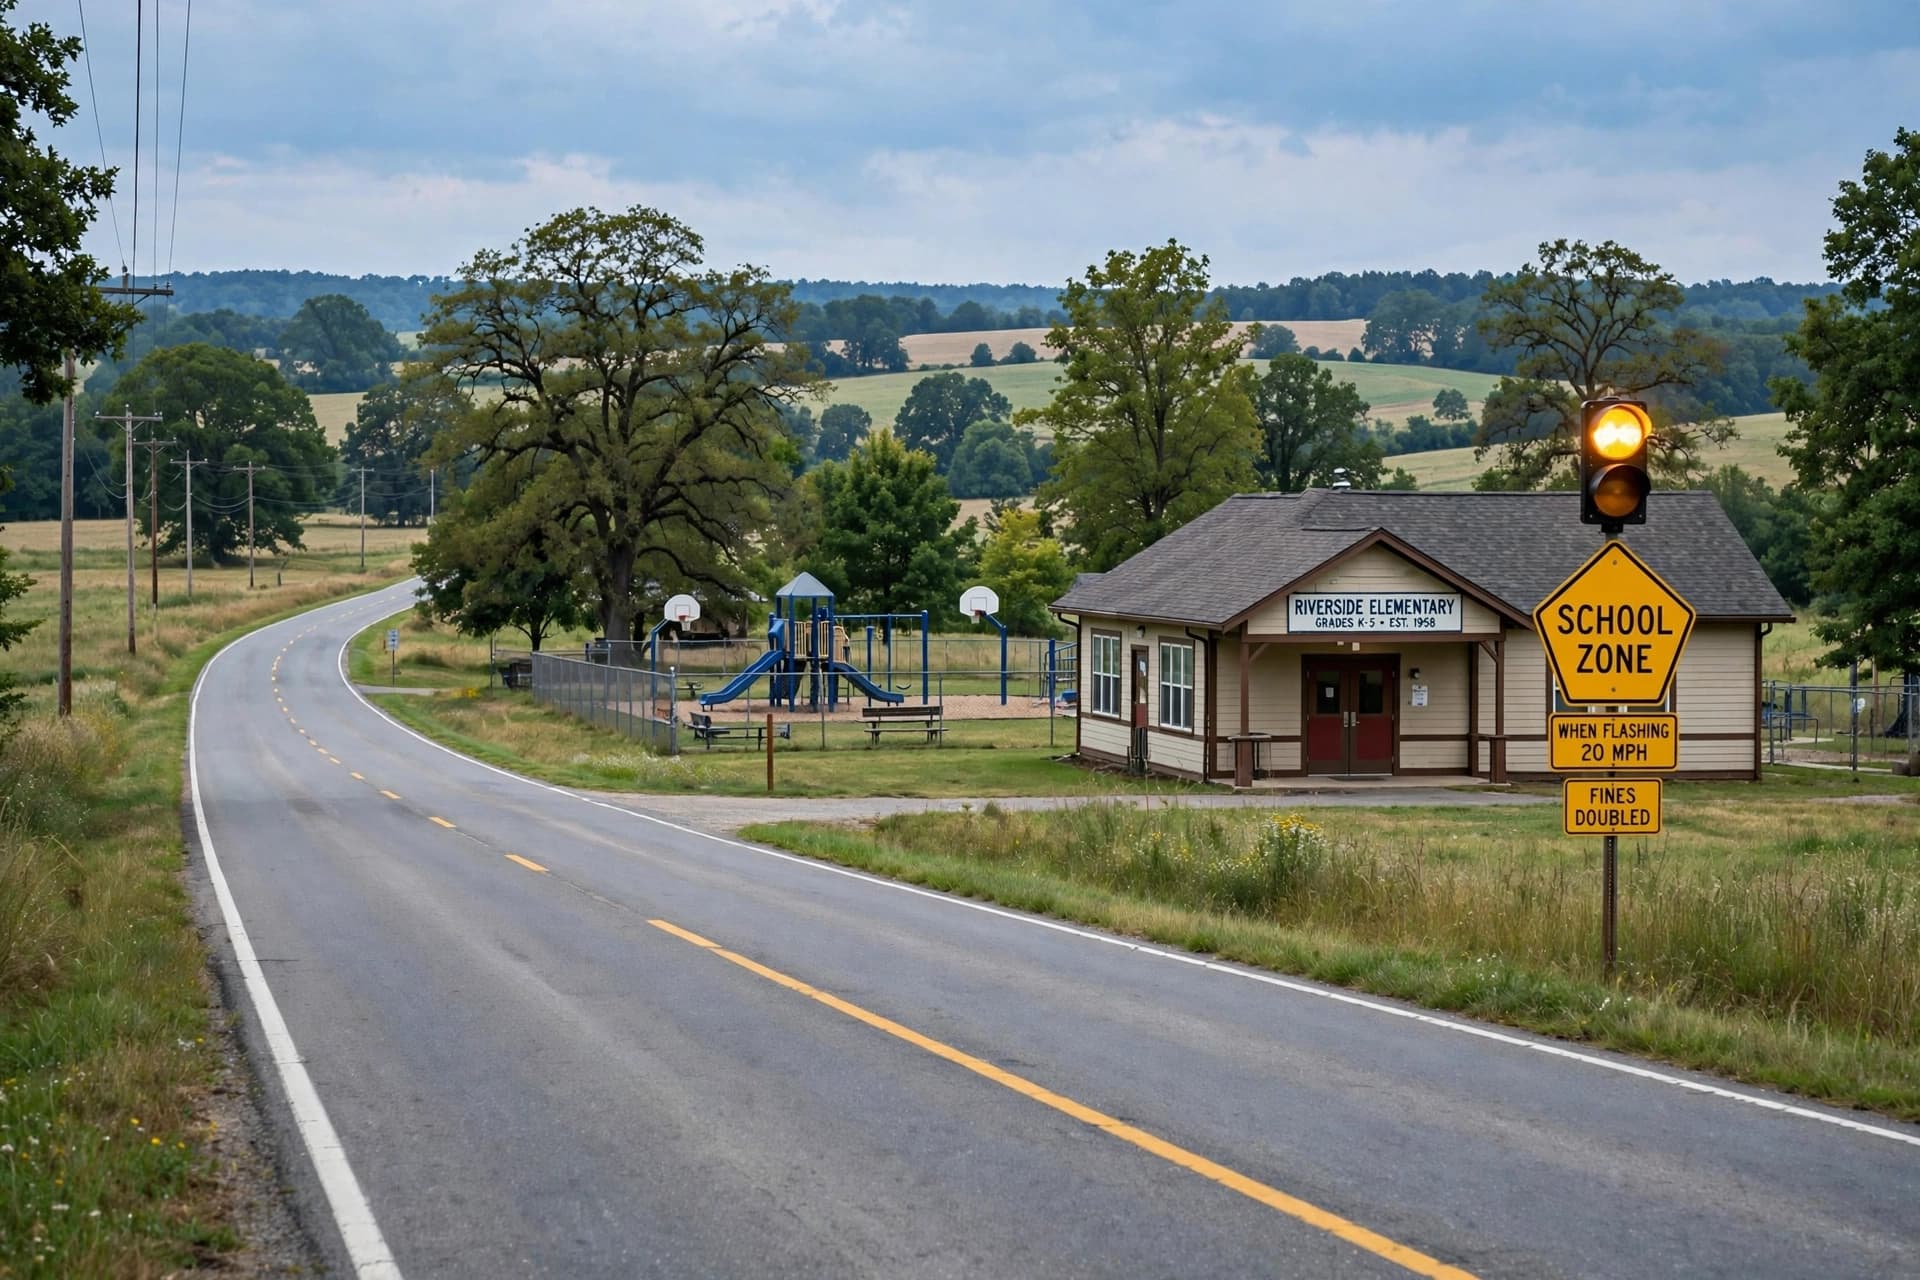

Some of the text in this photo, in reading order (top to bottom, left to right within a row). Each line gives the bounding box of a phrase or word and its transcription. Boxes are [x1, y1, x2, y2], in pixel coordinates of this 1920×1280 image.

[1294, 599, 1456, 616] RIVERSIDE ELEMENTARY
[1315, 617, 1436, 628] GRADES K-5 EST. 1958
[1557, 604, 1673, 635] SCHOOL
[1577, 644, 1653, 674] ZONE
[1558, 723, 1670, 739] WHEN FLASHING
[1581, 744, 1647, 761] 20 MPH
[1590, 787, 1636, 804] FINES
[1575, 809, 1651, 826] DOUBLED
